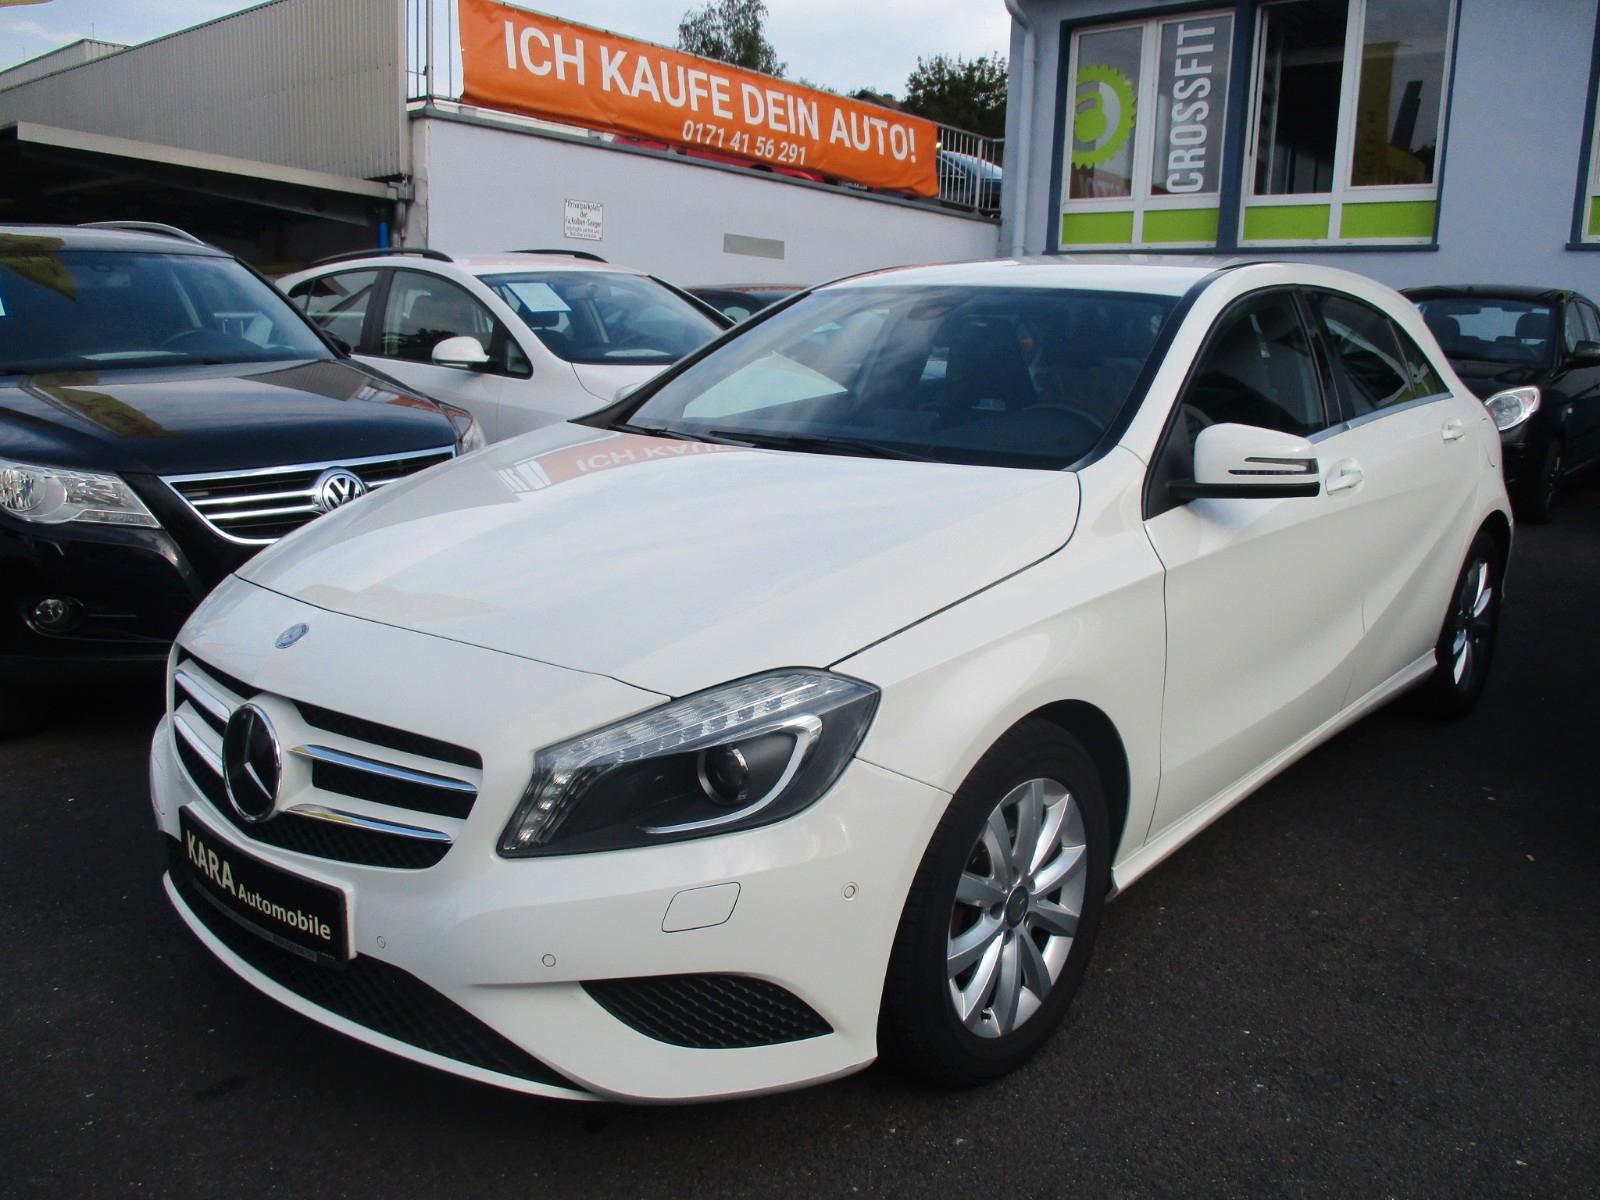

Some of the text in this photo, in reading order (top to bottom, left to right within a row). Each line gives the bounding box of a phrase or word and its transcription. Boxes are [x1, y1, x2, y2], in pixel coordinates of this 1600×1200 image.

[504, 20, 917, 164] ICH KAUFE DEIN AUTO!
[682, 119, 806, 166] 0171 41 56 291
[1166, 23, 1216, 193] CROSSFIT
[186, 829, 332, 941] KARA Automobile
